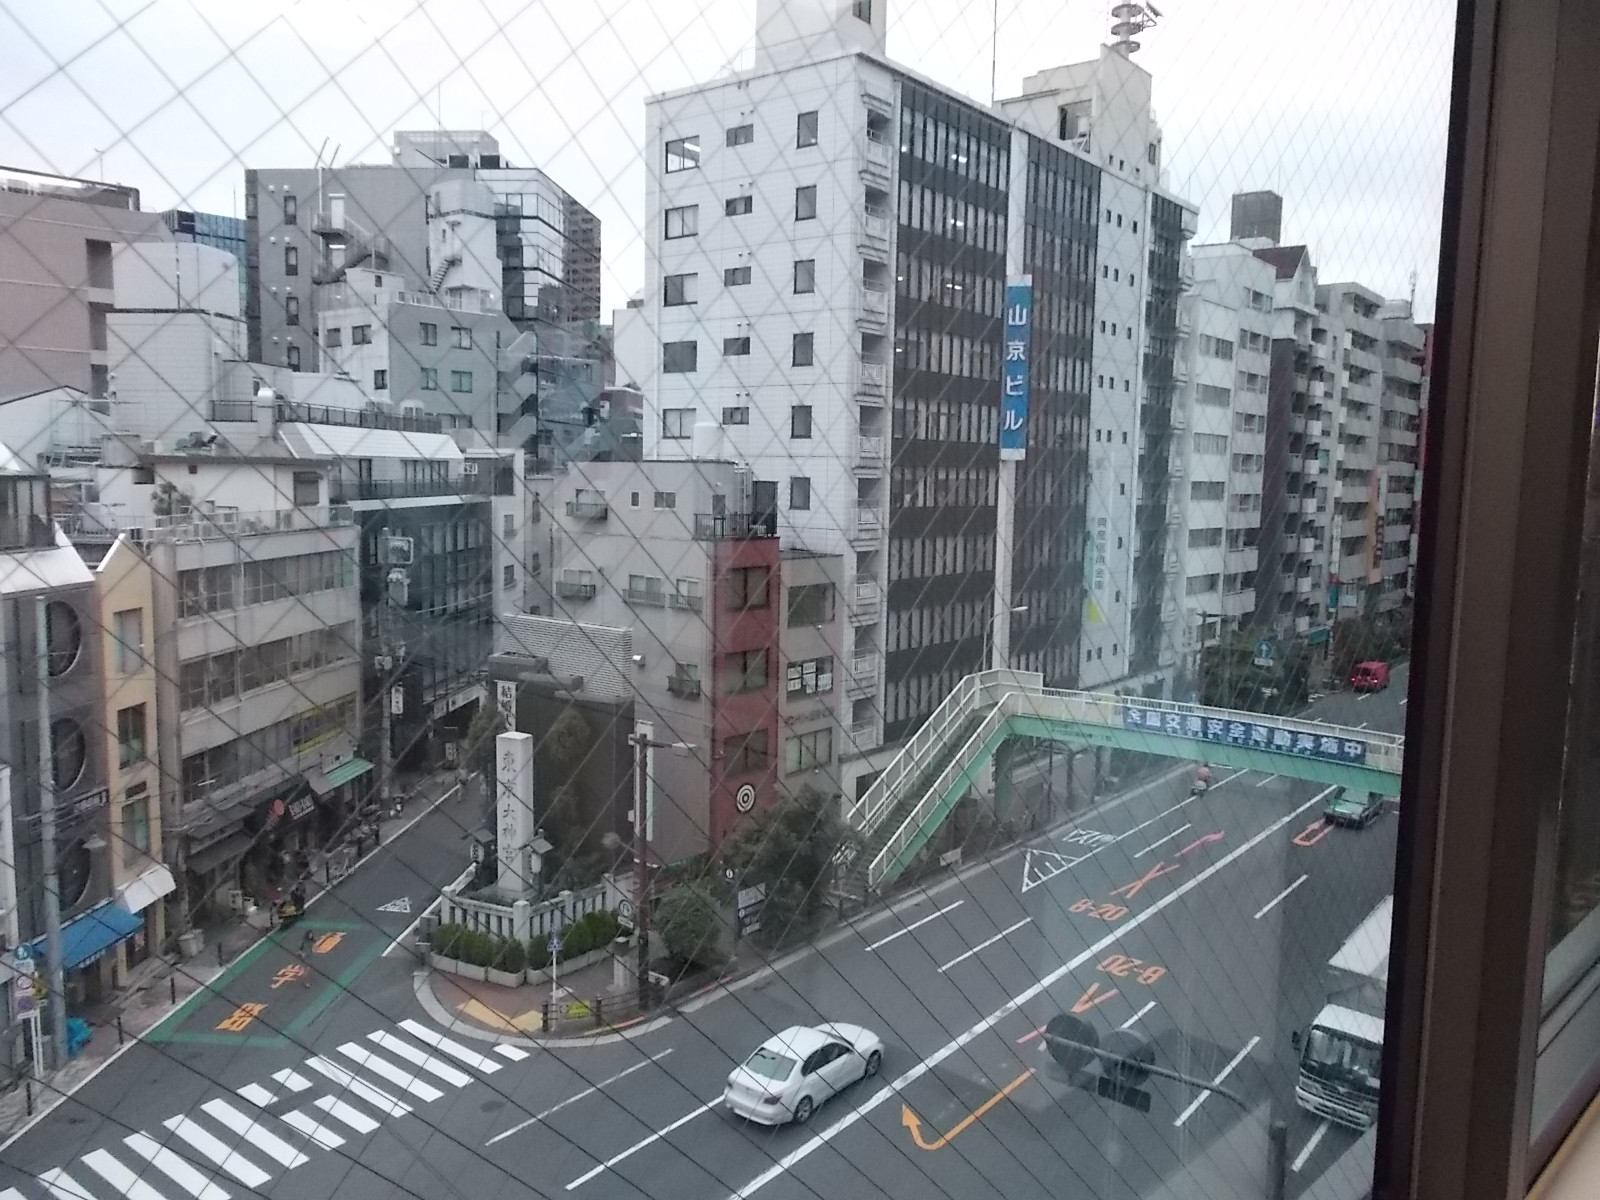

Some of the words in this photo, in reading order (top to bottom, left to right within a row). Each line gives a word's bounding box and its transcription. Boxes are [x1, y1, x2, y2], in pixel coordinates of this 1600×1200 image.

[1003, 303, 1028, 431] 山京ビル
[501, 750, 517, 865] 東京大神宮
[1068, 898, 1129, 921] 8-20
[1095, 954, 1167, 984] 8-20
